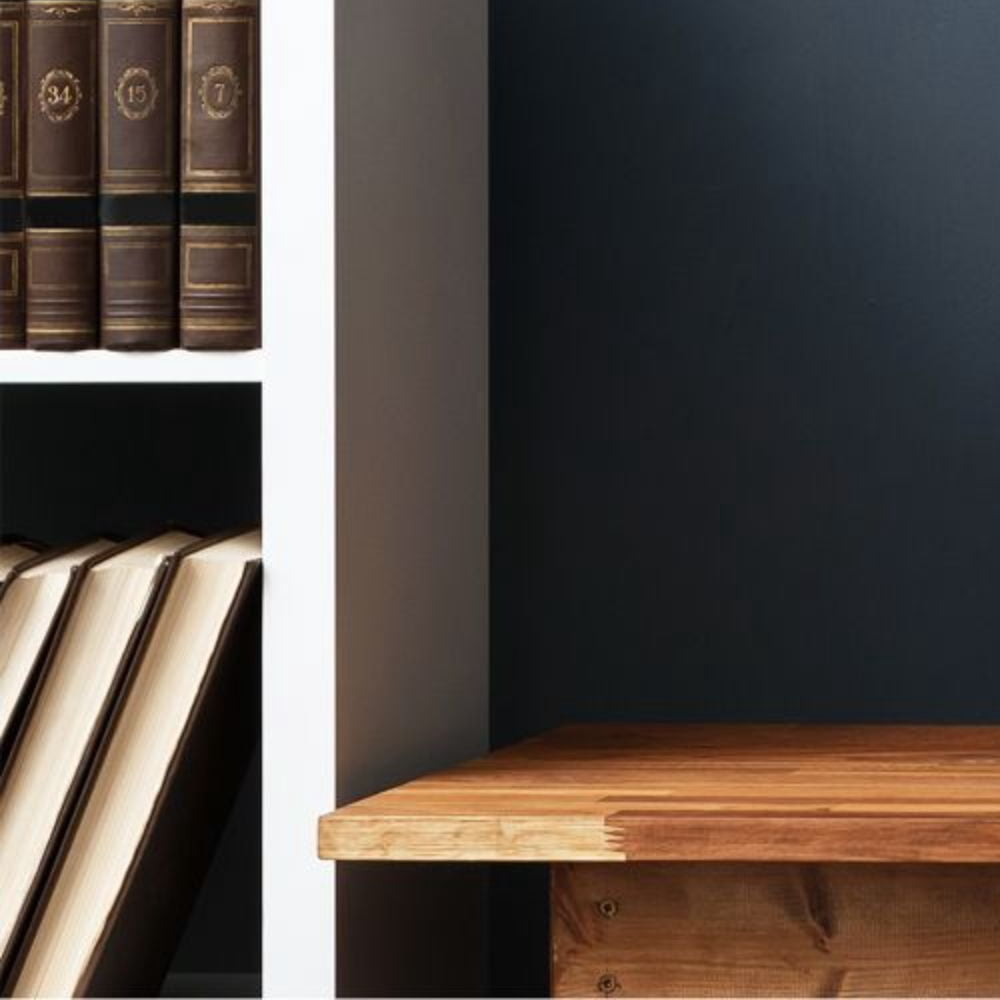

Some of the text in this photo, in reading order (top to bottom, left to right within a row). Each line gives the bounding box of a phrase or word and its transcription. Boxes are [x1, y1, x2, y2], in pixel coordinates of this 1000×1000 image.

[48, 86, 72, 104] 34
[127, 84, 146, 103] 15
[215, 83, 225, 103] 7
